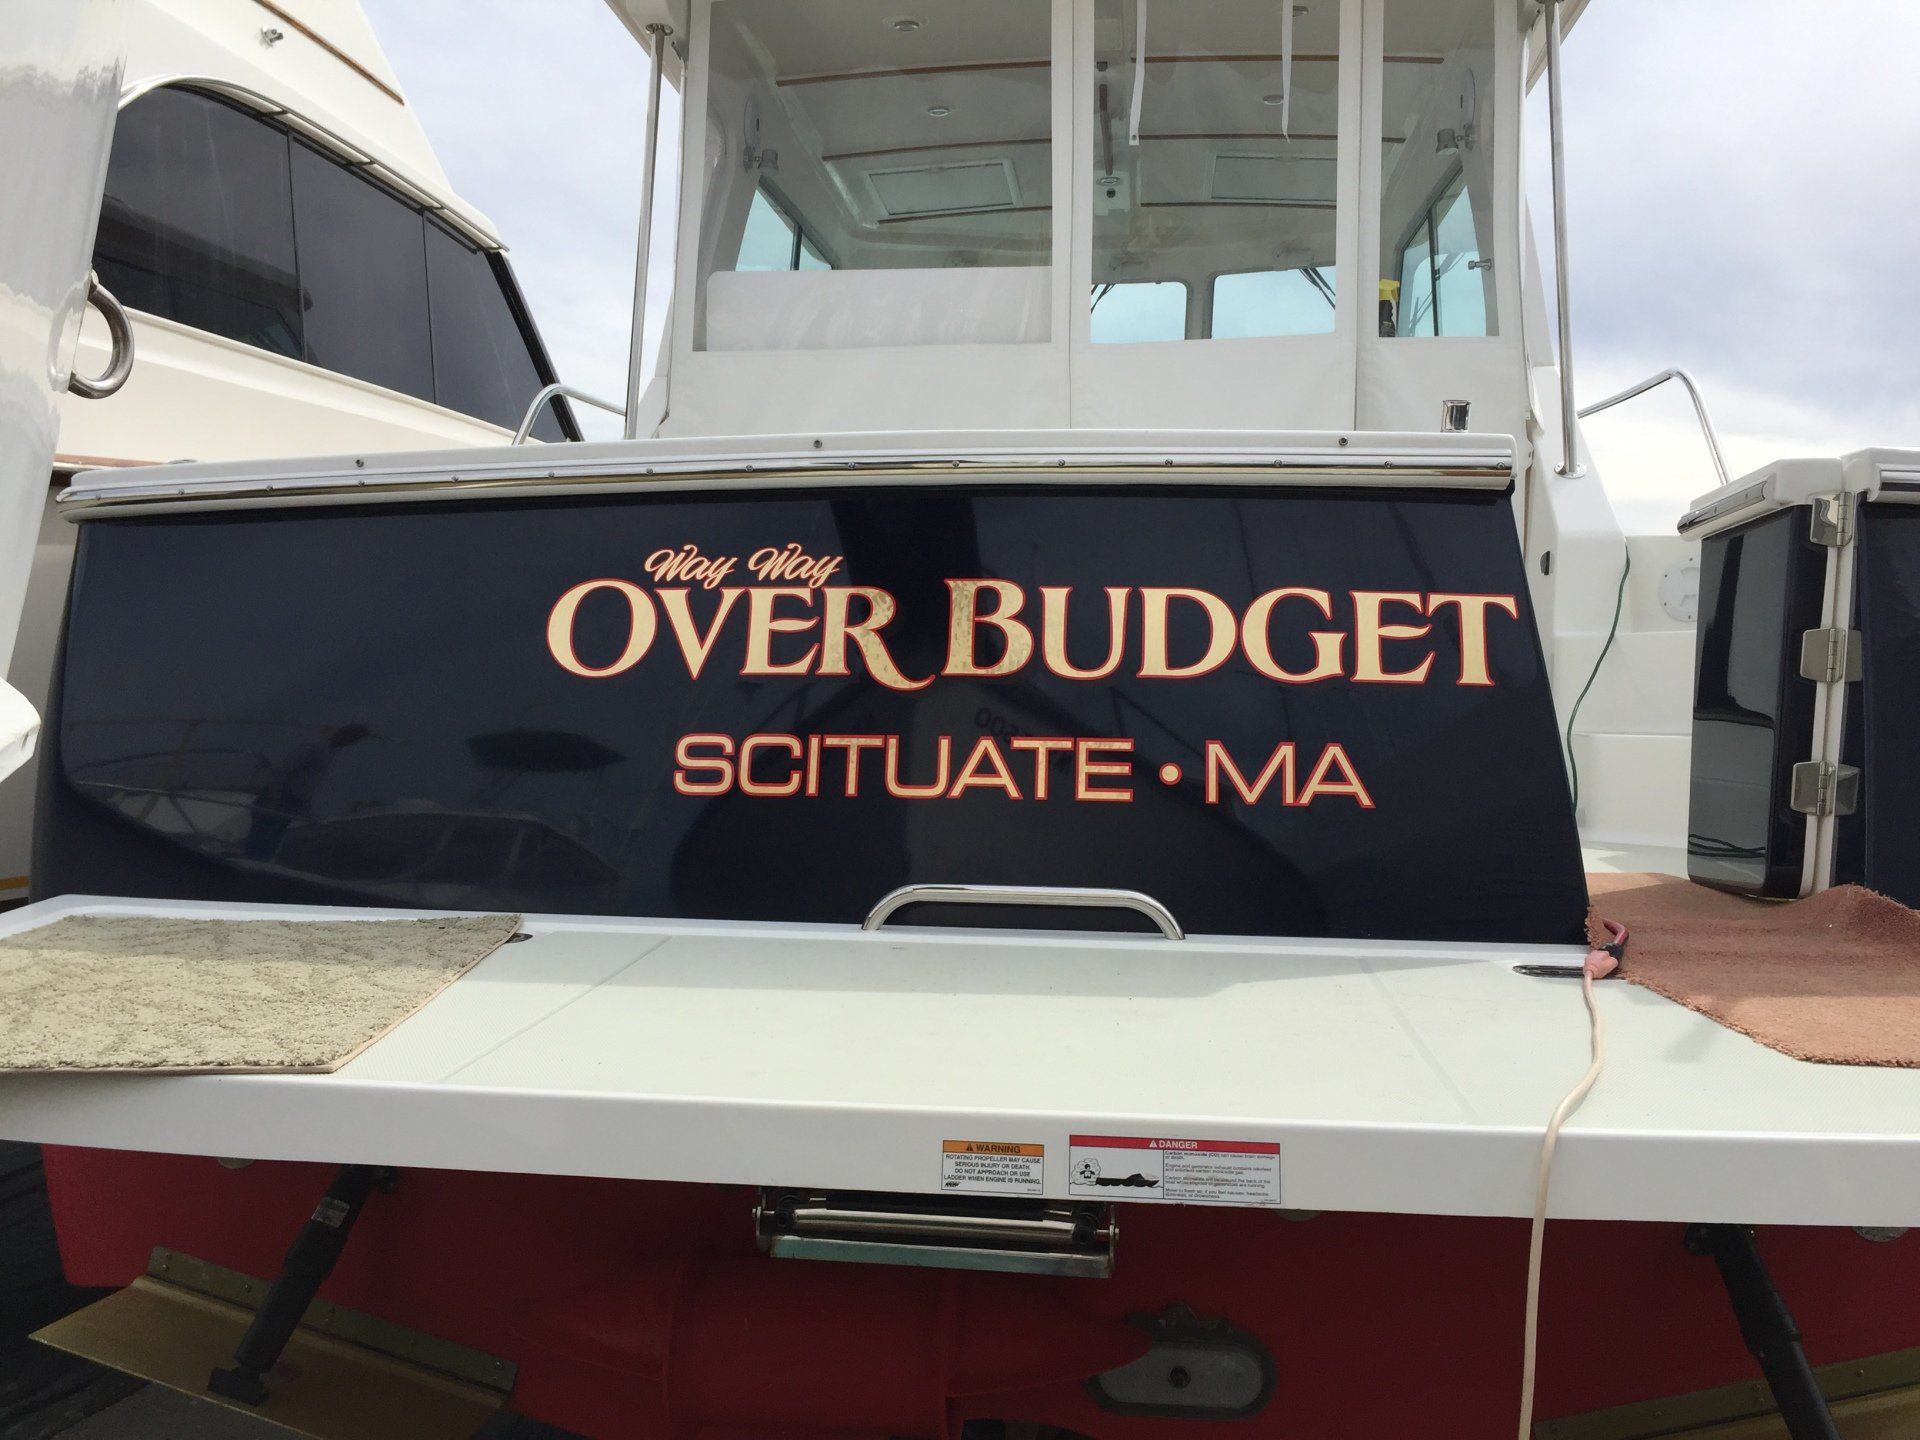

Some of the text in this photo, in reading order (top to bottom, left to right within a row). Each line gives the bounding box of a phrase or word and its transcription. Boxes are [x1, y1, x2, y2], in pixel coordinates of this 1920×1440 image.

[643, 542, 845, 590] Way Way
[546, 577, 1519, 691] OVER BUDGET
[673, 732, 1376, 809] SCITUATE MA
[976, 1143, 1020, 1154] WARNING
[1158, 1140, 1198, 1149] DANGER
